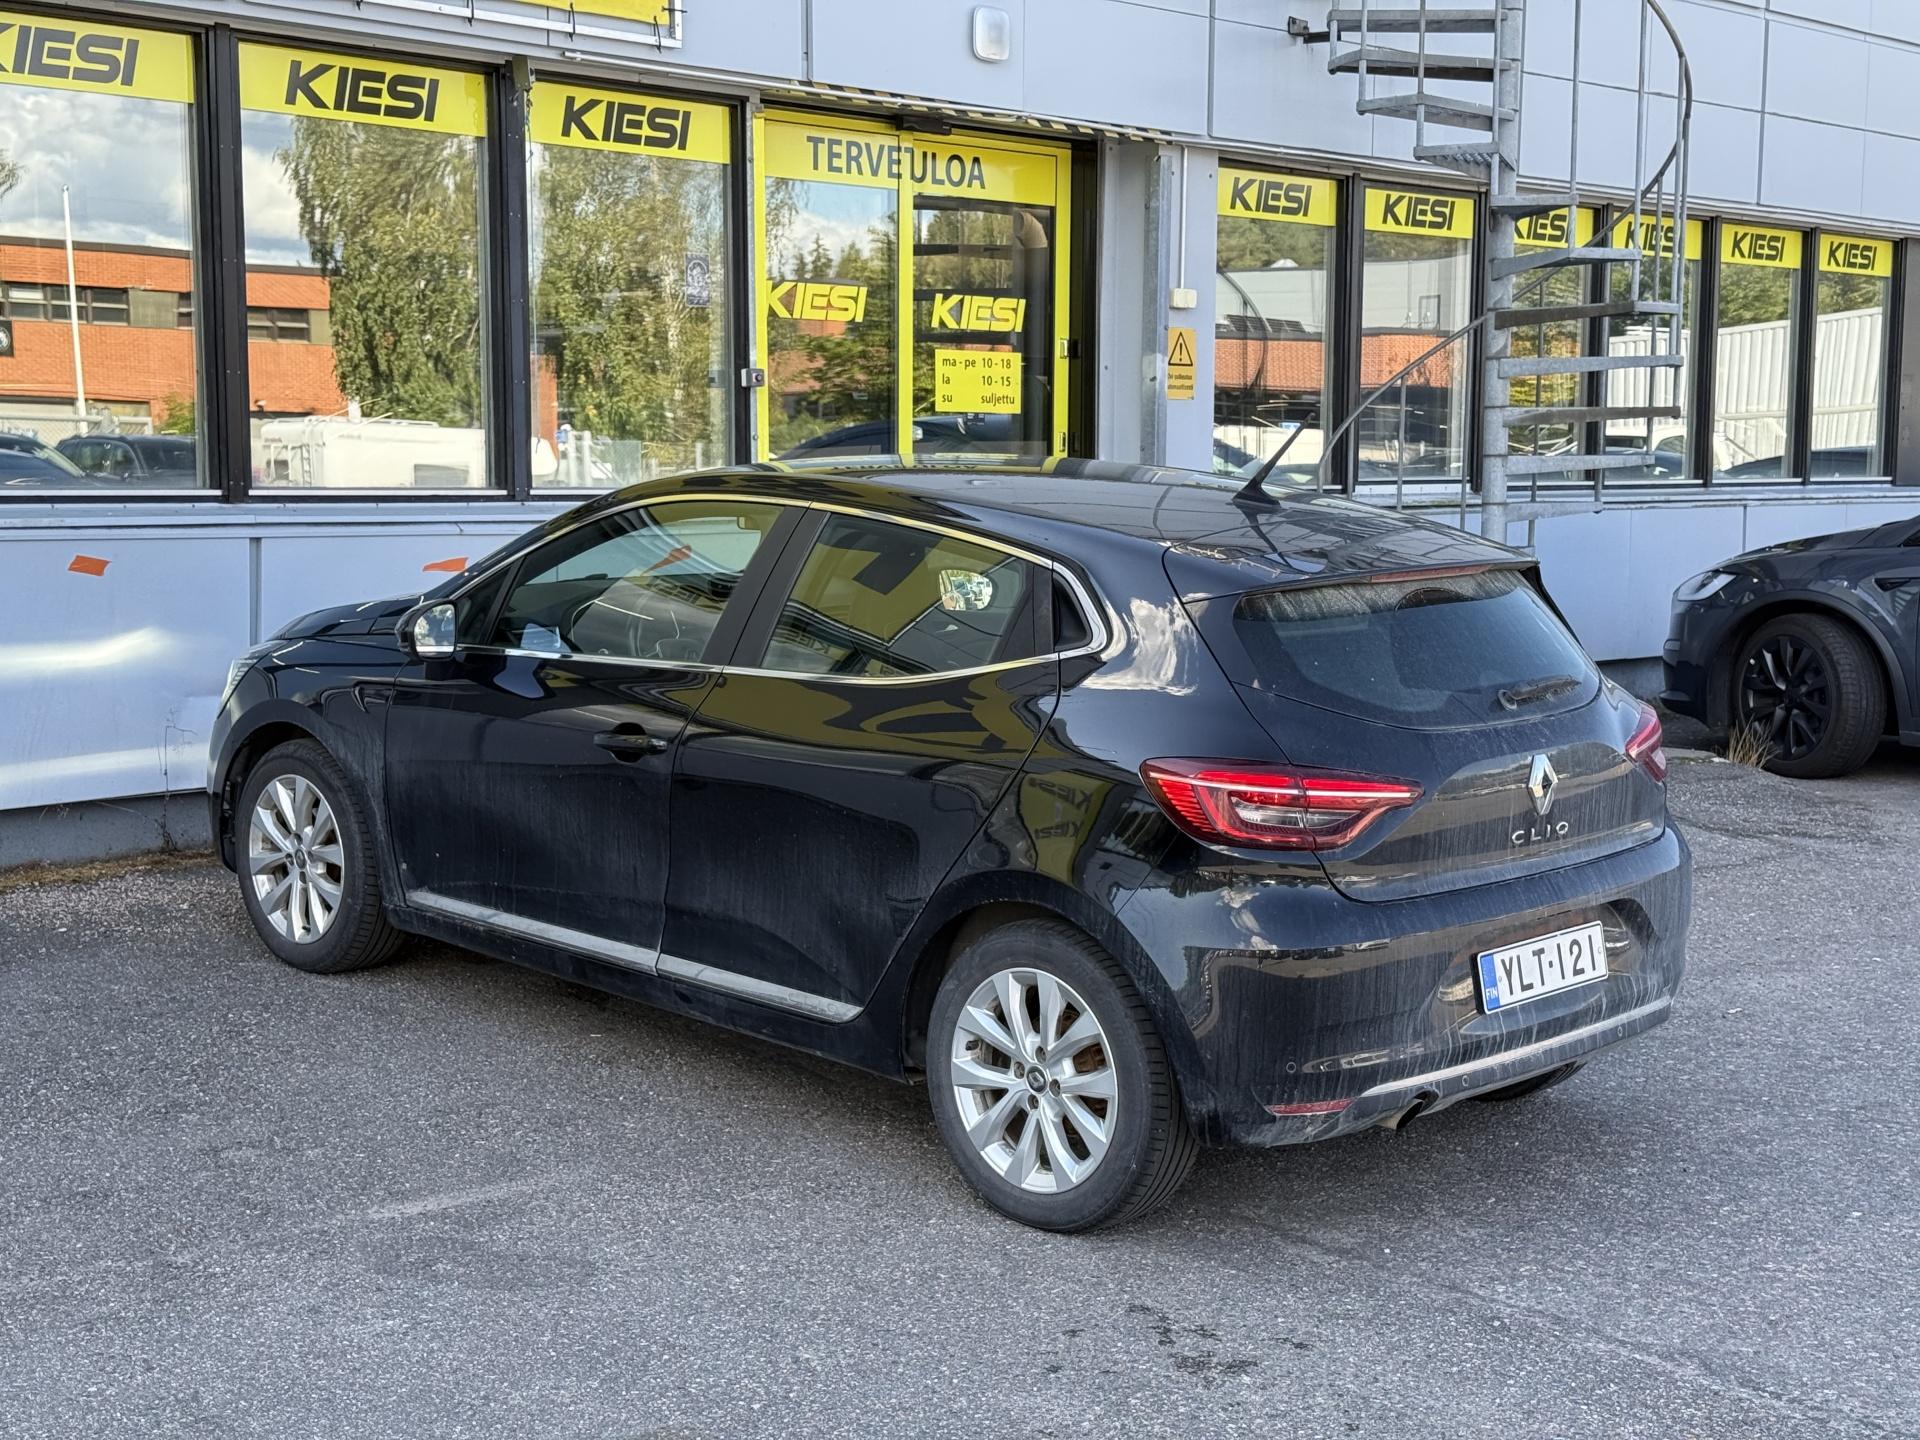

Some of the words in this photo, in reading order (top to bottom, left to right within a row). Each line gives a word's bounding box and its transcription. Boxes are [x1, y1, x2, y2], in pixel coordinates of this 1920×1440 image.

[285, 60, 439, 122] KIESI
[561, 95, 692, 151] KIESI
[1230, 177, 1312, 217] KIESI
[1382, 194, 1455, 231] KIESI
[1731, 231, 1786, 262] KIESI
[1827, 241, 1877, 271] KIESI
[766, 280, 868, 322] KIESI
[931, 293, 1026, 332] KIESI
[942, 373, 951, 385] la
[942, 394, 953, 403] su
[981, 392, 1015, 407] suljettu
[1512, 821, 1569, 844] CLIO
[1501, 934, 1597, 997] YLT-121
